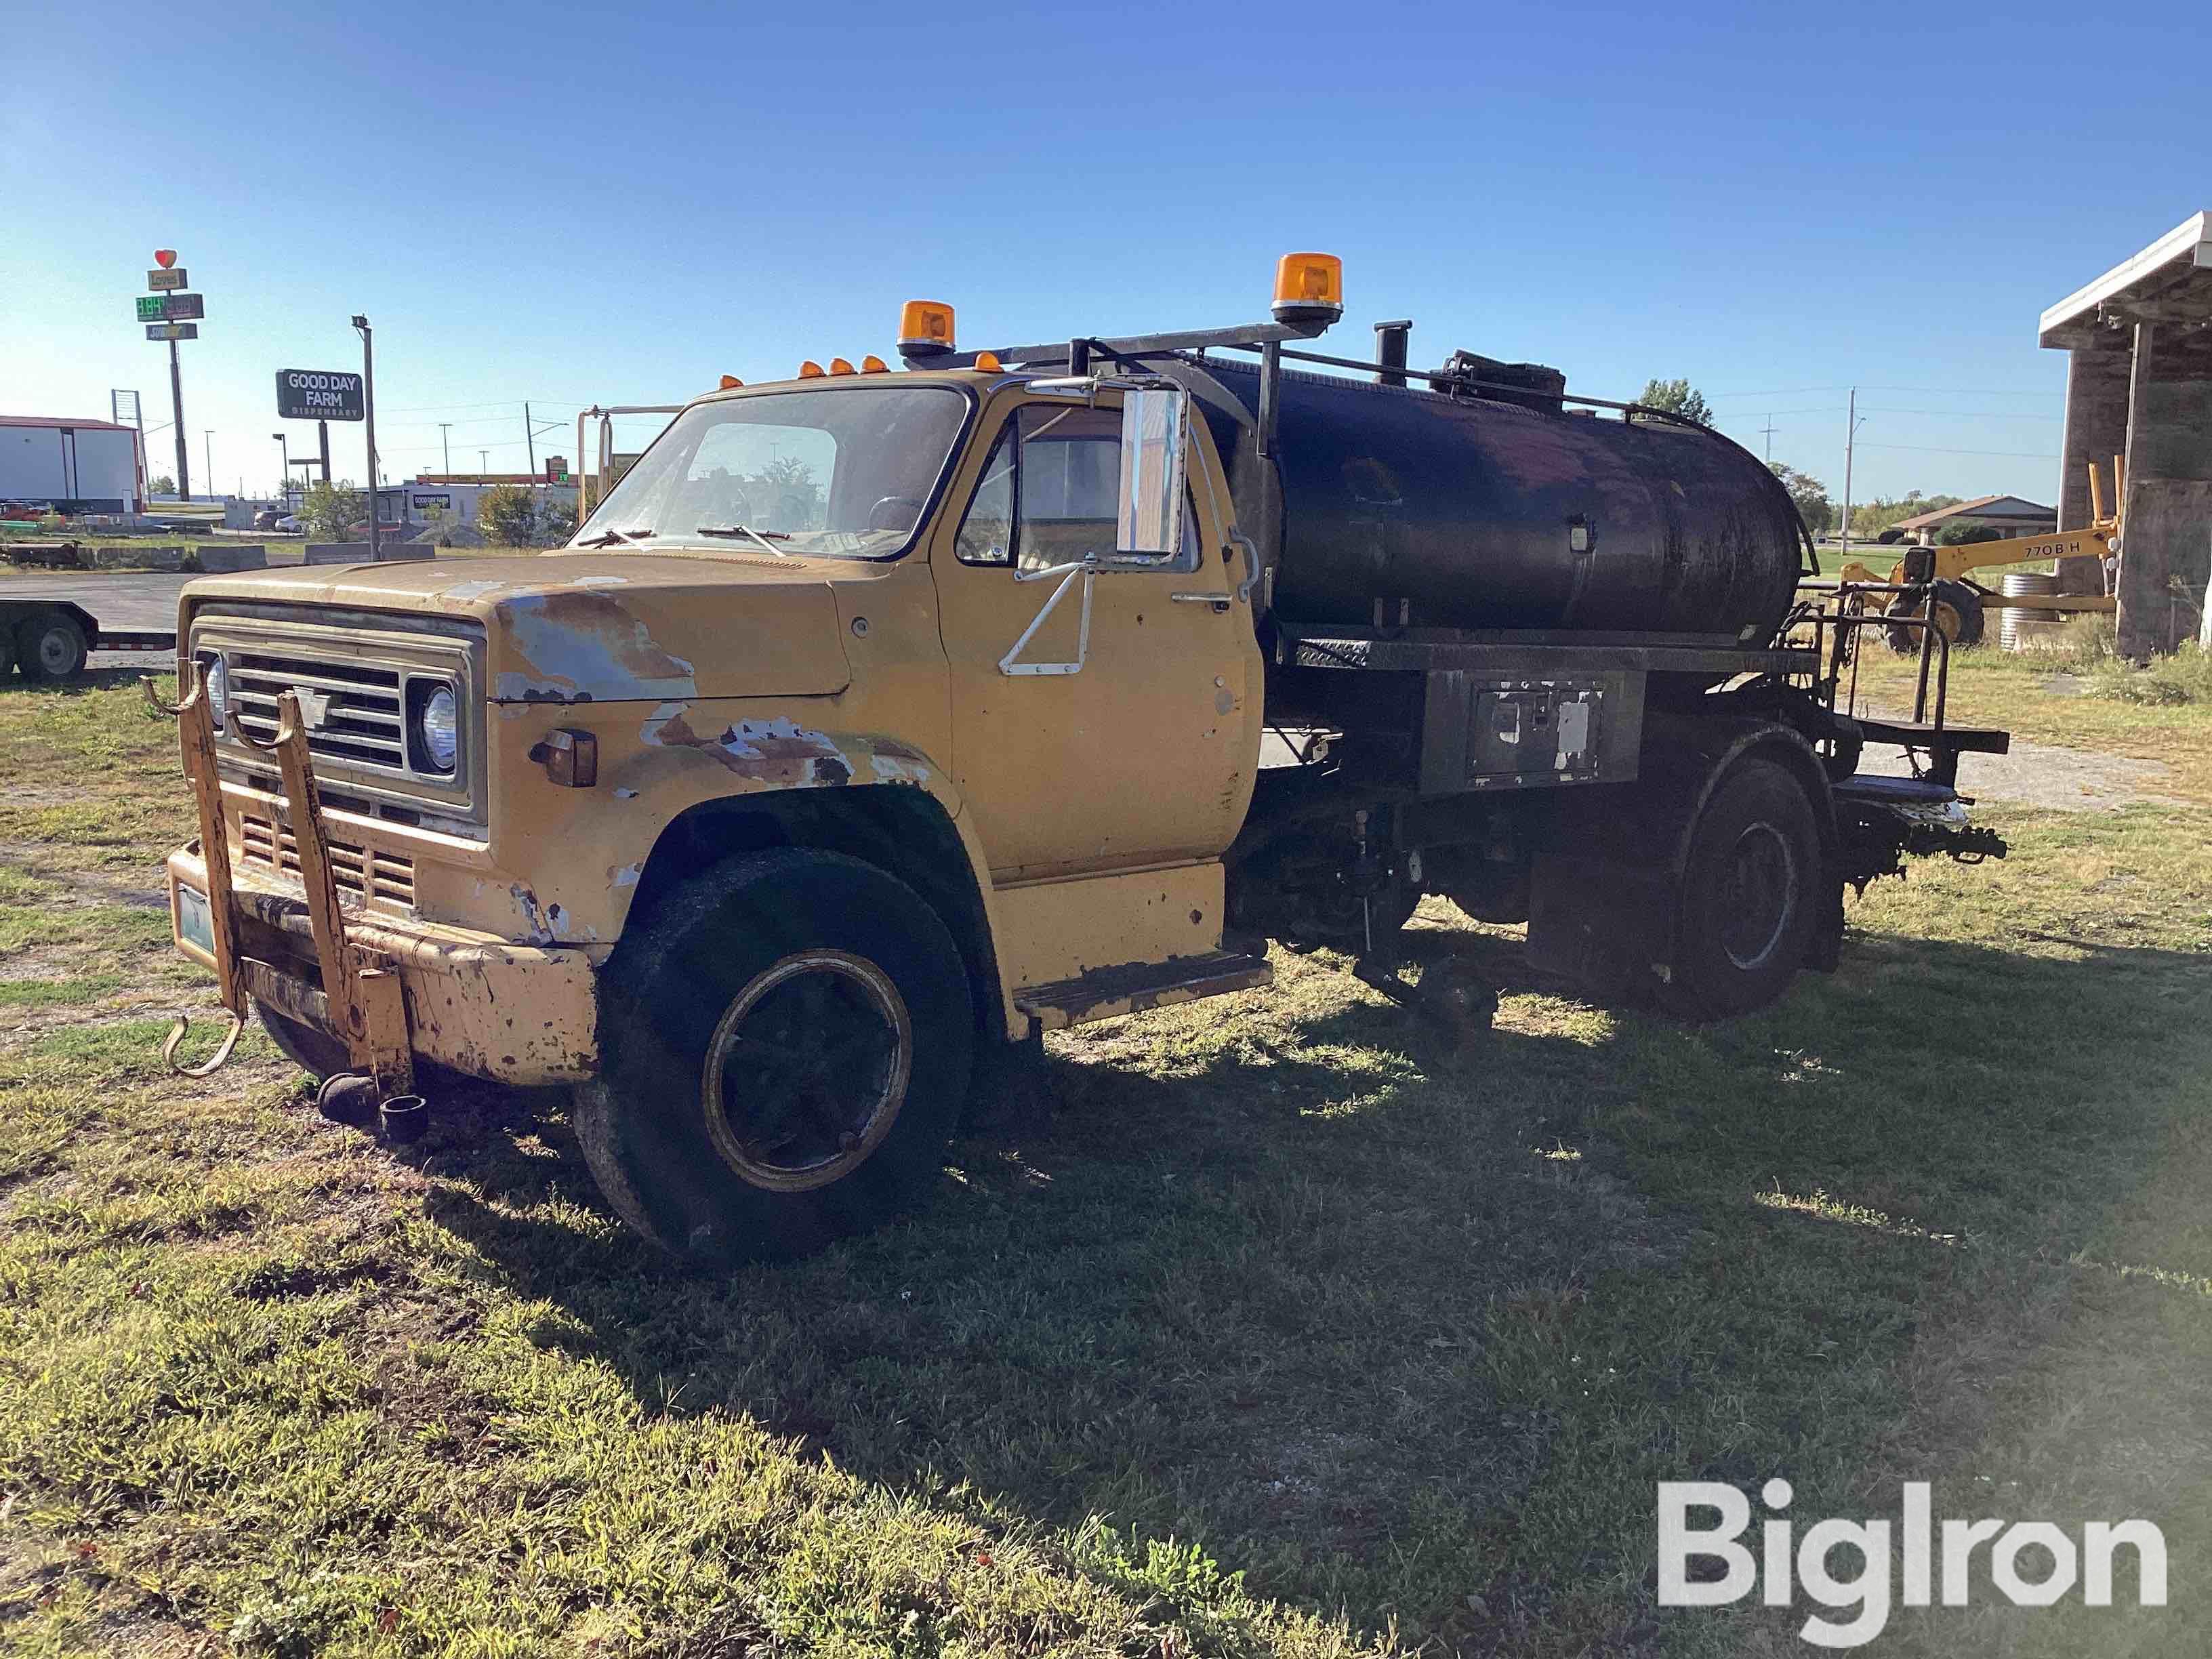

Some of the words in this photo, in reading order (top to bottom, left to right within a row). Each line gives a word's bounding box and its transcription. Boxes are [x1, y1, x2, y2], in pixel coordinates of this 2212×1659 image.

[289, 373, 328, 390] GOOD
[331, 375, 356, 391] DAY
[306, 391, 342, 407] FARM
